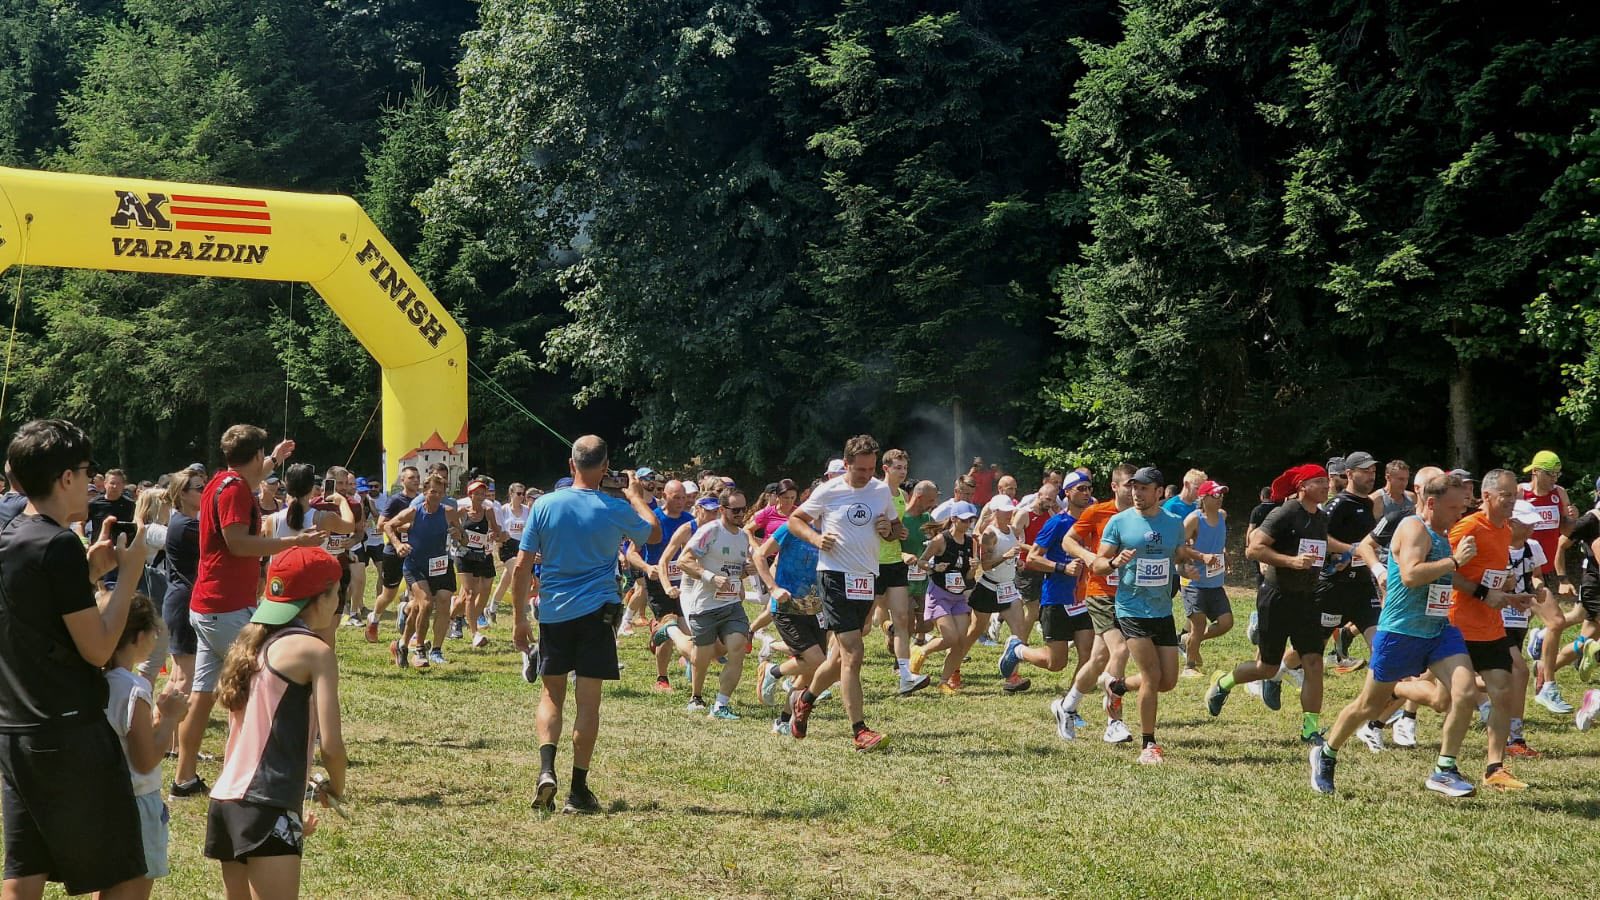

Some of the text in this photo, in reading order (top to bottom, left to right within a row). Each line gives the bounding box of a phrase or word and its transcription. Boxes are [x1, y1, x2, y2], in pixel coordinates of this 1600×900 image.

[111, 191, 171, 230] AK
[112, 235, 268, 263] VARAŽDIN
[356, 239, 447, 348] FINISH
[1309, 545, 1319, 554] 34
[1145, 564, 1164, 575] 820
[854, 578, 868, 589] 176
[1492, 576, 1502, 588] 51
